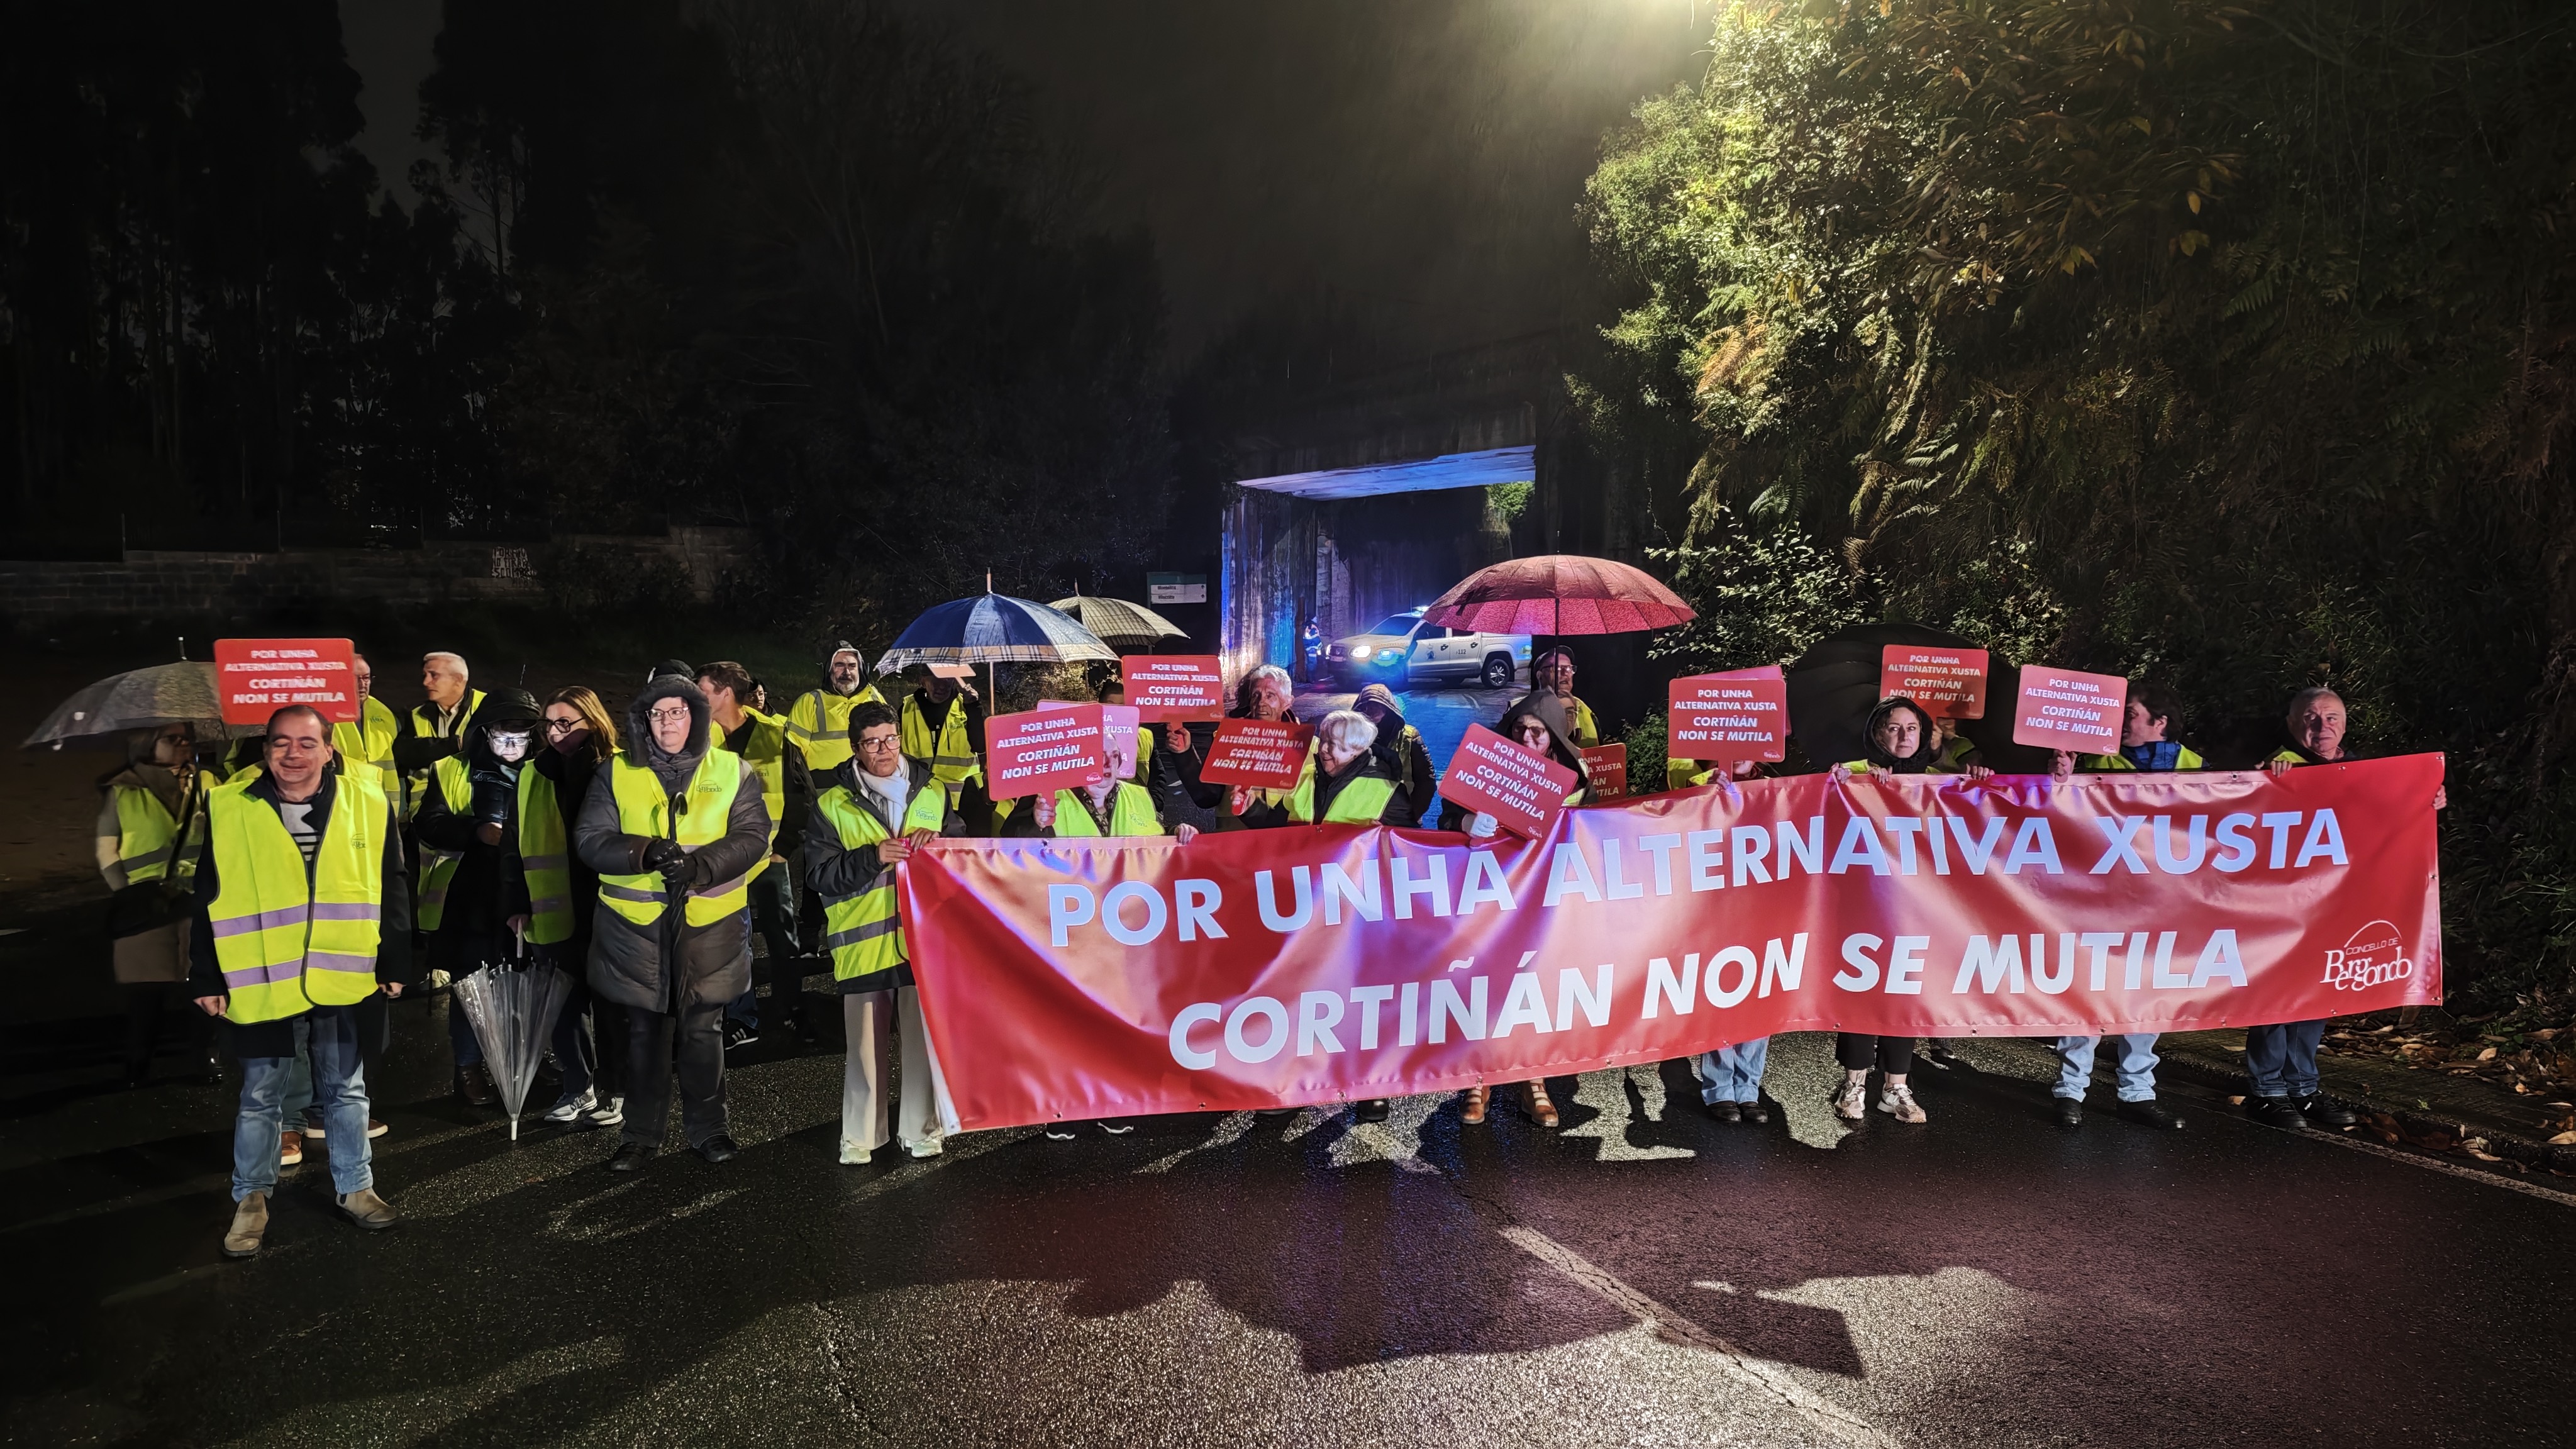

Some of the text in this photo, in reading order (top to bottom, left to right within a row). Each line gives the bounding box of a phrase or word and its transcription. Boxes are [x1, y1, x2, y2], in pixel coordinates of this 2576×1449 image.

[1909, 655, 1960, 665] POR UNHA
[1131, 673, 1190, 681] ALTERNATIVA
[1888, 663, 1980, 677] ALTERNATIVA XUSTA
[1698, 690, 1753, 698] POR UNHA
[2049, 679, 2100, 693] POR UNHA
[1136, 697, 1161, 706] NON
[1178, 698, 1216, 707] MUTILA
[1889, 689, 1975, 702] NON SE MUTILA
[2025, 687, 2120, 708] ALTERNATIVA XUSTA
[1674, 701, 1778, 711] ALTERNATIVA XUSTA
[1021, 718, 1075, 733] POR UNHA
[2026, 717, 2113, 737] NON SE MUTILA
[996, 726, 1099, 748] ALTERNATIVA XUSTA
[1678, 731, 1773, 742] NON SE MUTILA
[1017, 743, 1080, 762] CORTIÑÁN
[1494, 741, 1545, 774] POR UNHA
[1002, 757, 1095, 779] NON SE MUTILA
[1465, 741, 1562, 795] ALTERNATIVA XUSTA
[1596, 762, 1622, 772] XUSTA
[1477, 765, 1538, 800] CORTIÑÁN
[1455, 770, 1545, 820] NON SE MUTILA
[1596, 787, 1619, 797] TILA
[1047, 808, 2349, 948] POR UNHA ALTERNATIVA XUSTA
[2346, 937, 2399, 955] CONCELLO DE
[2319, 946, 2413, 991] Bergondo
[1169, 928, 2248, 1070] CORTIÑÁN NON SE MUTILA
